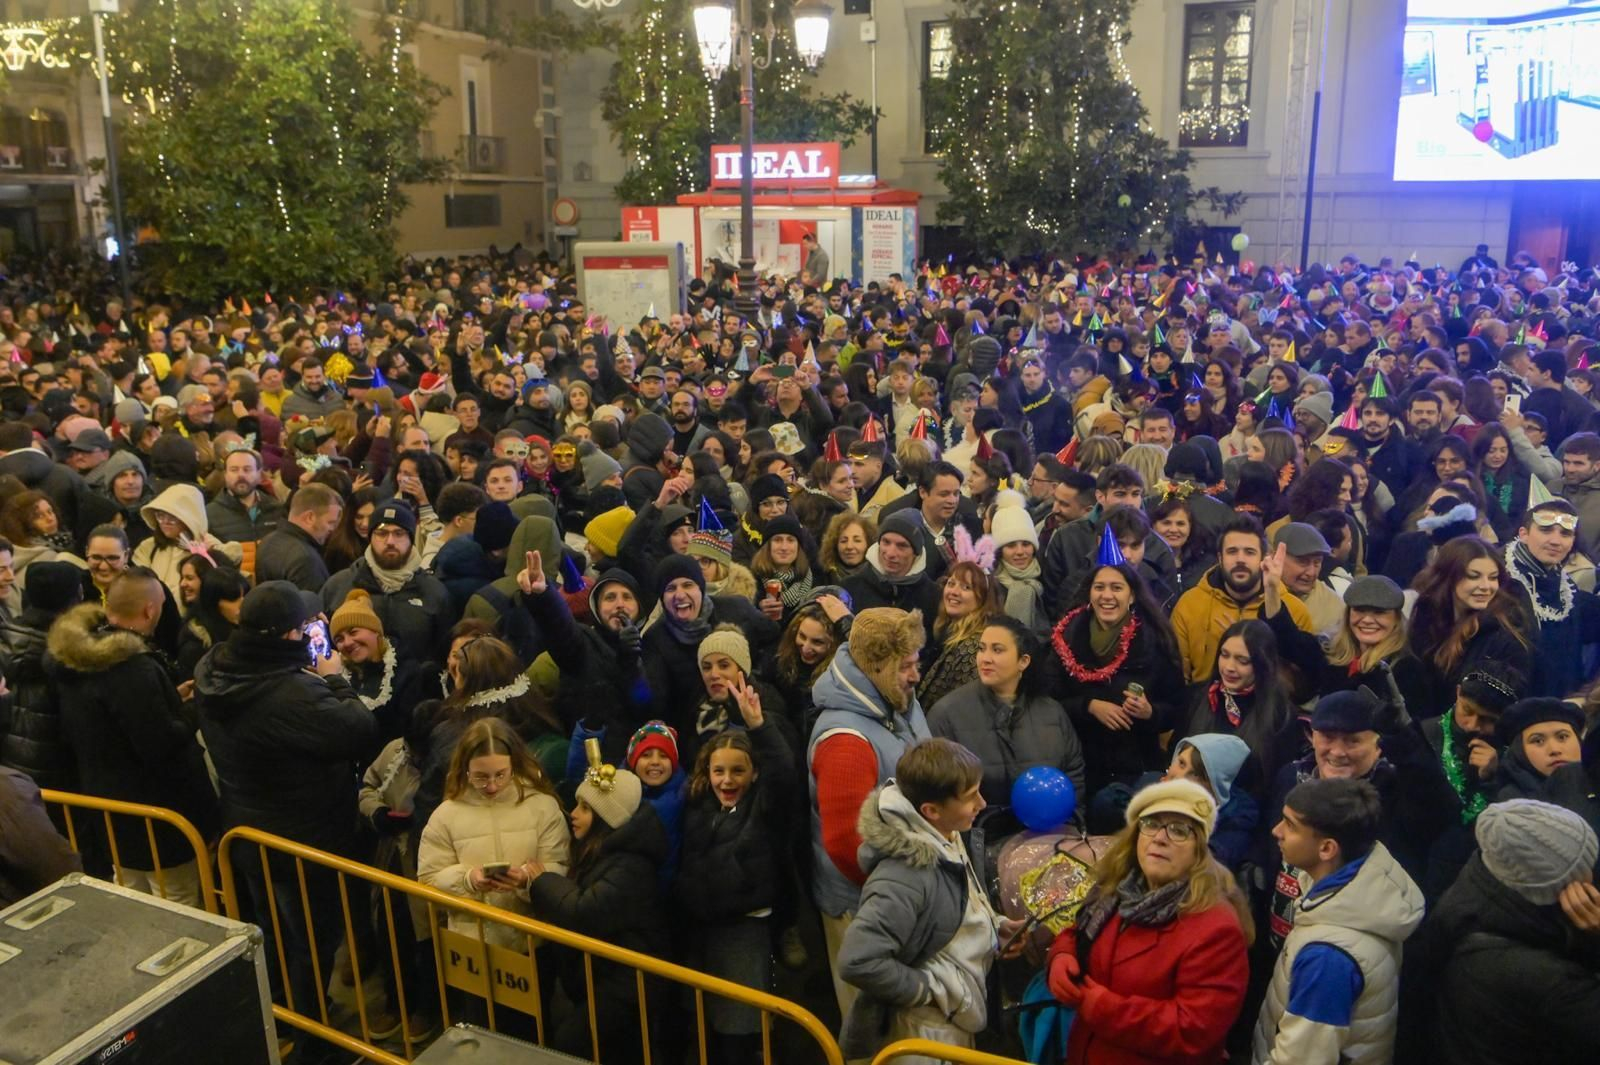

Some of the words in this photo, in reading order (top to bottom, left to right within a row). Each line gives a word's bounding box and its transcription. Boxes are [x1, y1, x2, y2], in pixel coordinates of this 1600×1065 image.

[714, 150, 831, 180] IDEAL
[866, 210, 901, 221] IDEAL
[495, 967, 529, 992] 150
